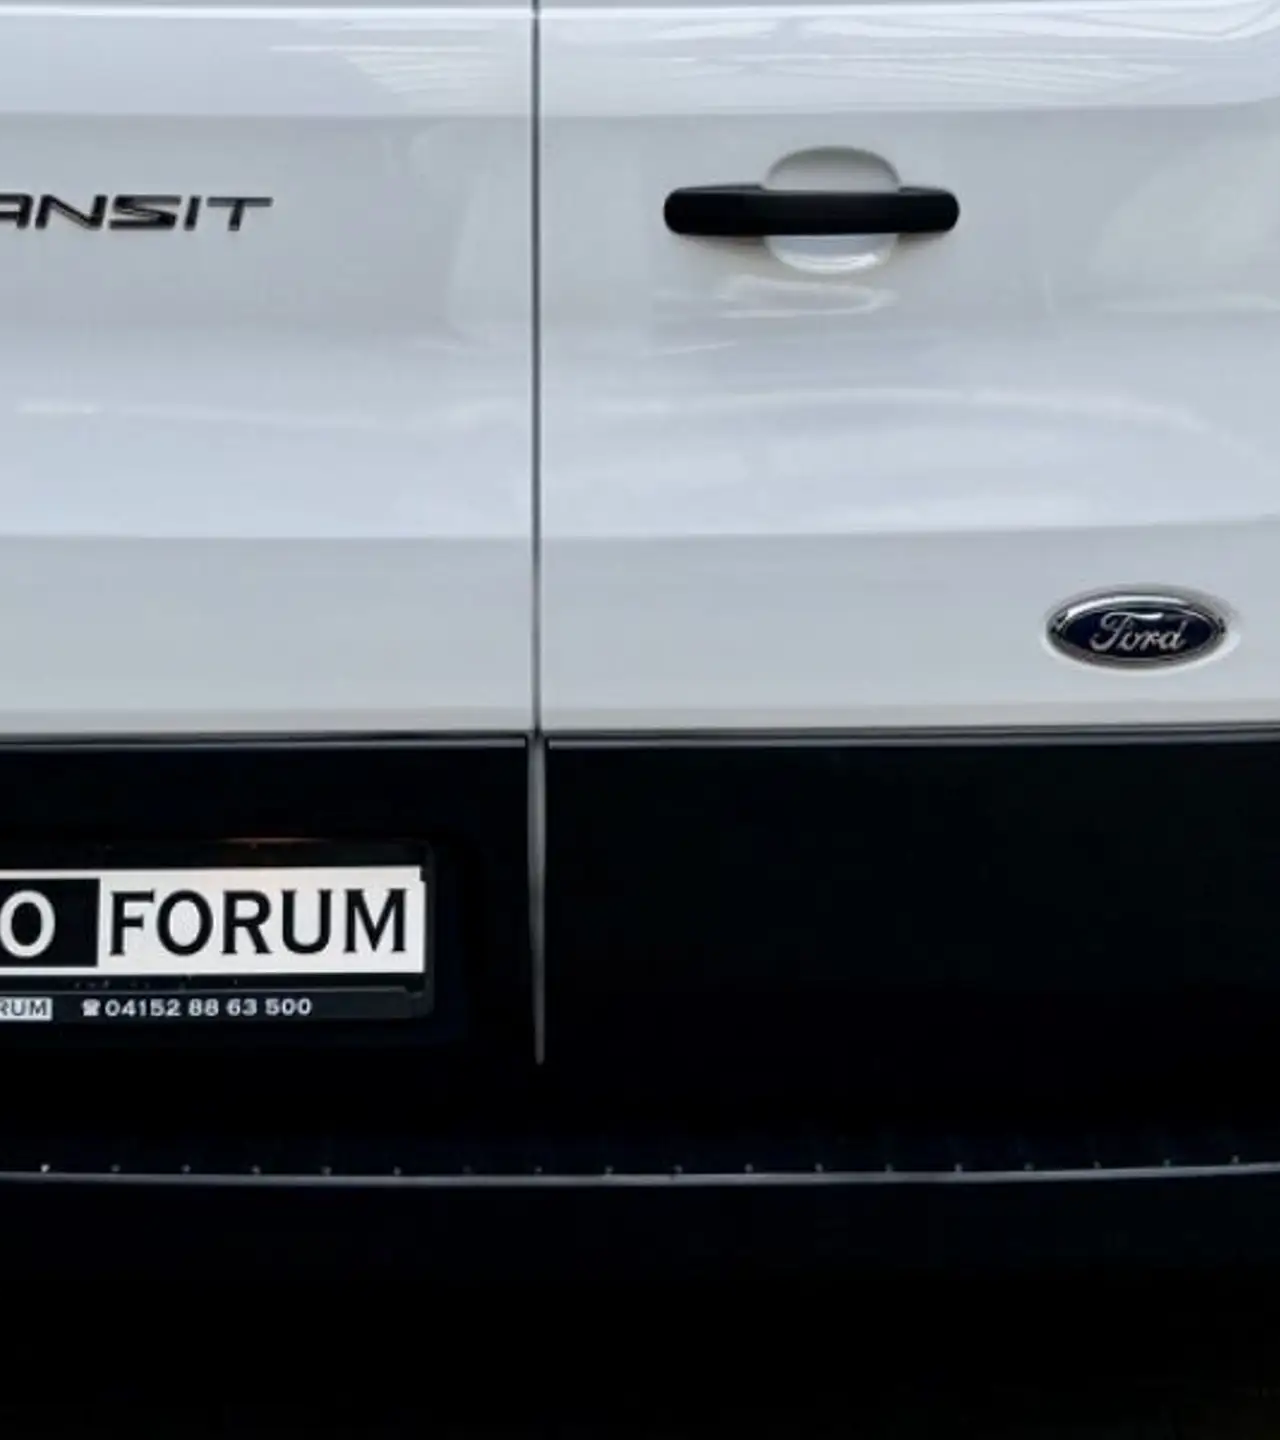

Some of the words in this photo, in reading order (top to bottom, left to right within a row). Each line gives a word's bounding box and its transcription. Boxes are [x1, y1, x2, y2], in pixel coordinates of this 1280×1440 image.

[1088, 611, 1189, 652] Ford
[109, 888, 408, 957] FORUM
[104, 998, 182, 1017] 04152
[188, 998, 219, 1017] 88
[226, 998, 258, 1017] 63
[265, 998, 313, 1017] 500
